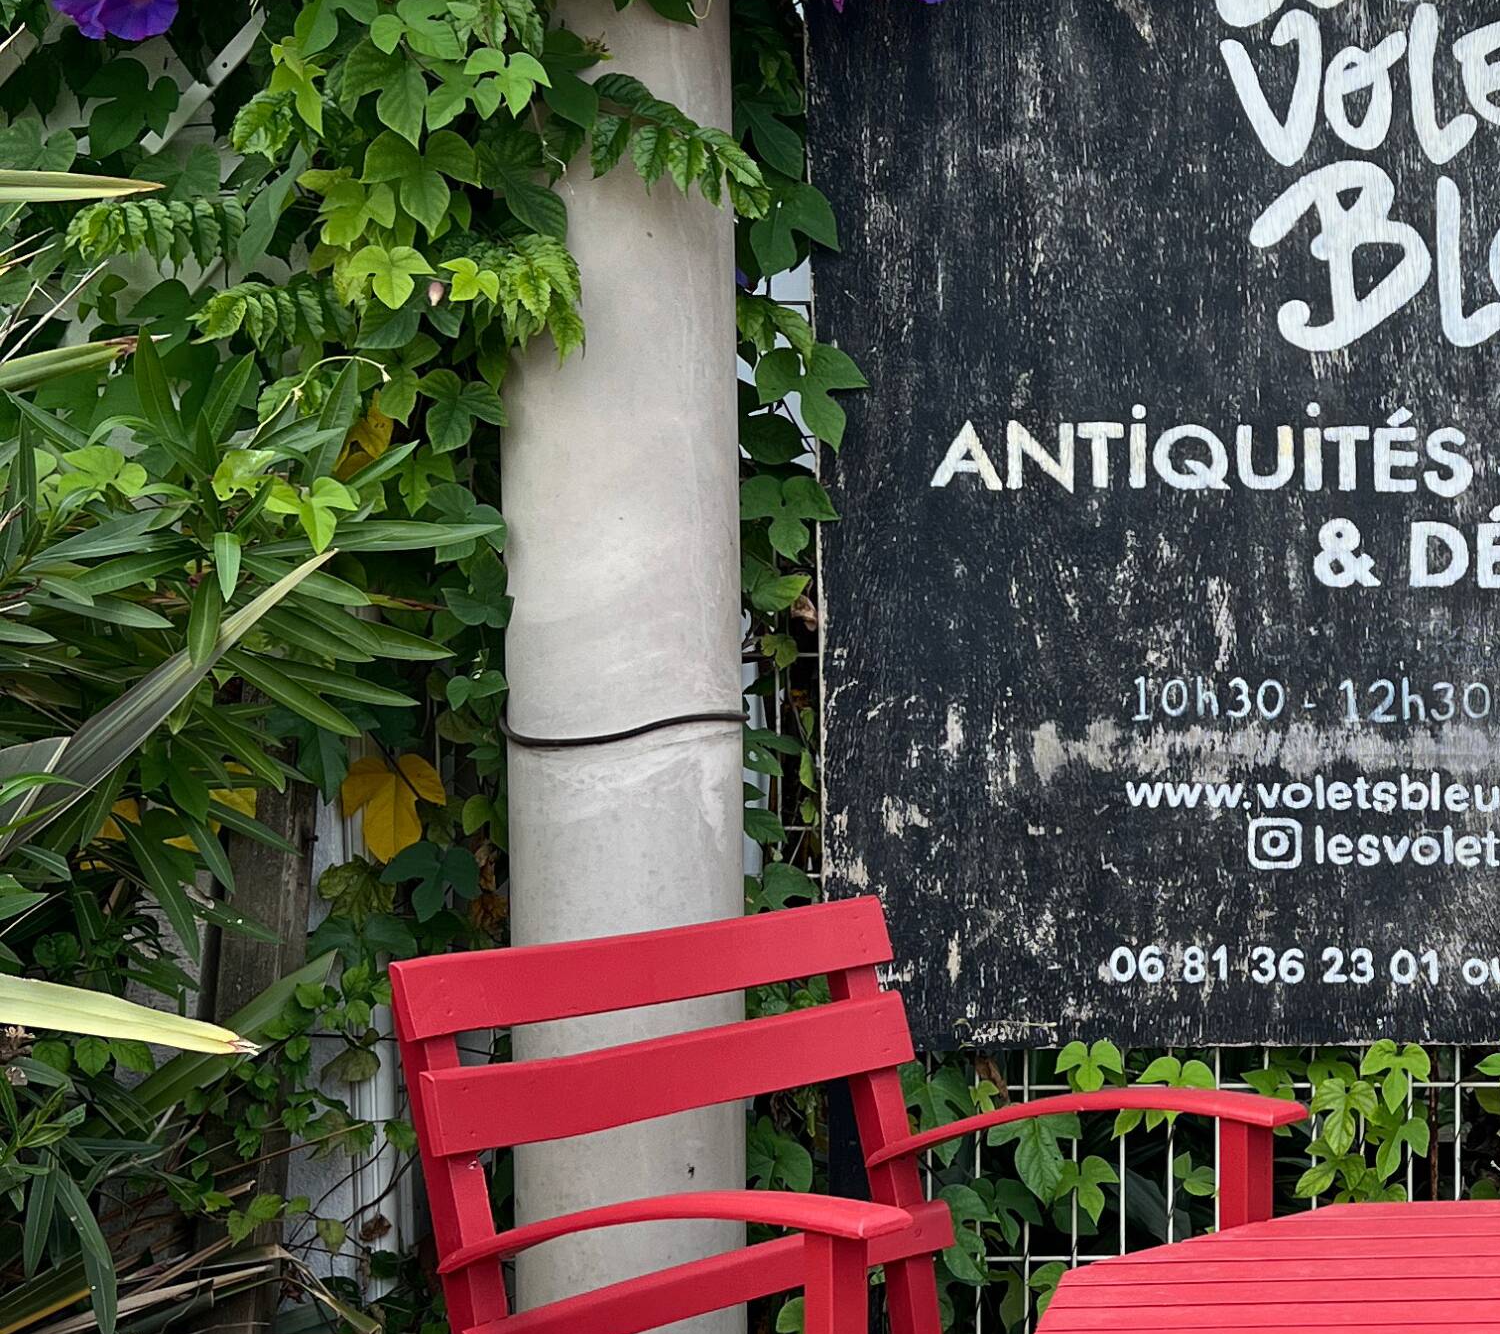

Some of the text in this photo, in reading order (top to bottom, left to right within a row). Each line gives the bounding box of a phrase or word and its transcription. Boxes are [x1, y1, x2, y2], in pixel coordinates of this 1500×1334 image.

[1312, 517, 1381, 588] &
[1131, 676, 1285, 722] 10h30
[1338, 676, 1491, 723] 12h30
[1109, 945, 1166, 984] 06
[1183, 944, 1228, 983] 81
[1251, 946, 1305, 985] 36
[1321, 946, 1375, 985] 23
[1390, 948, 1440, 986] 01
